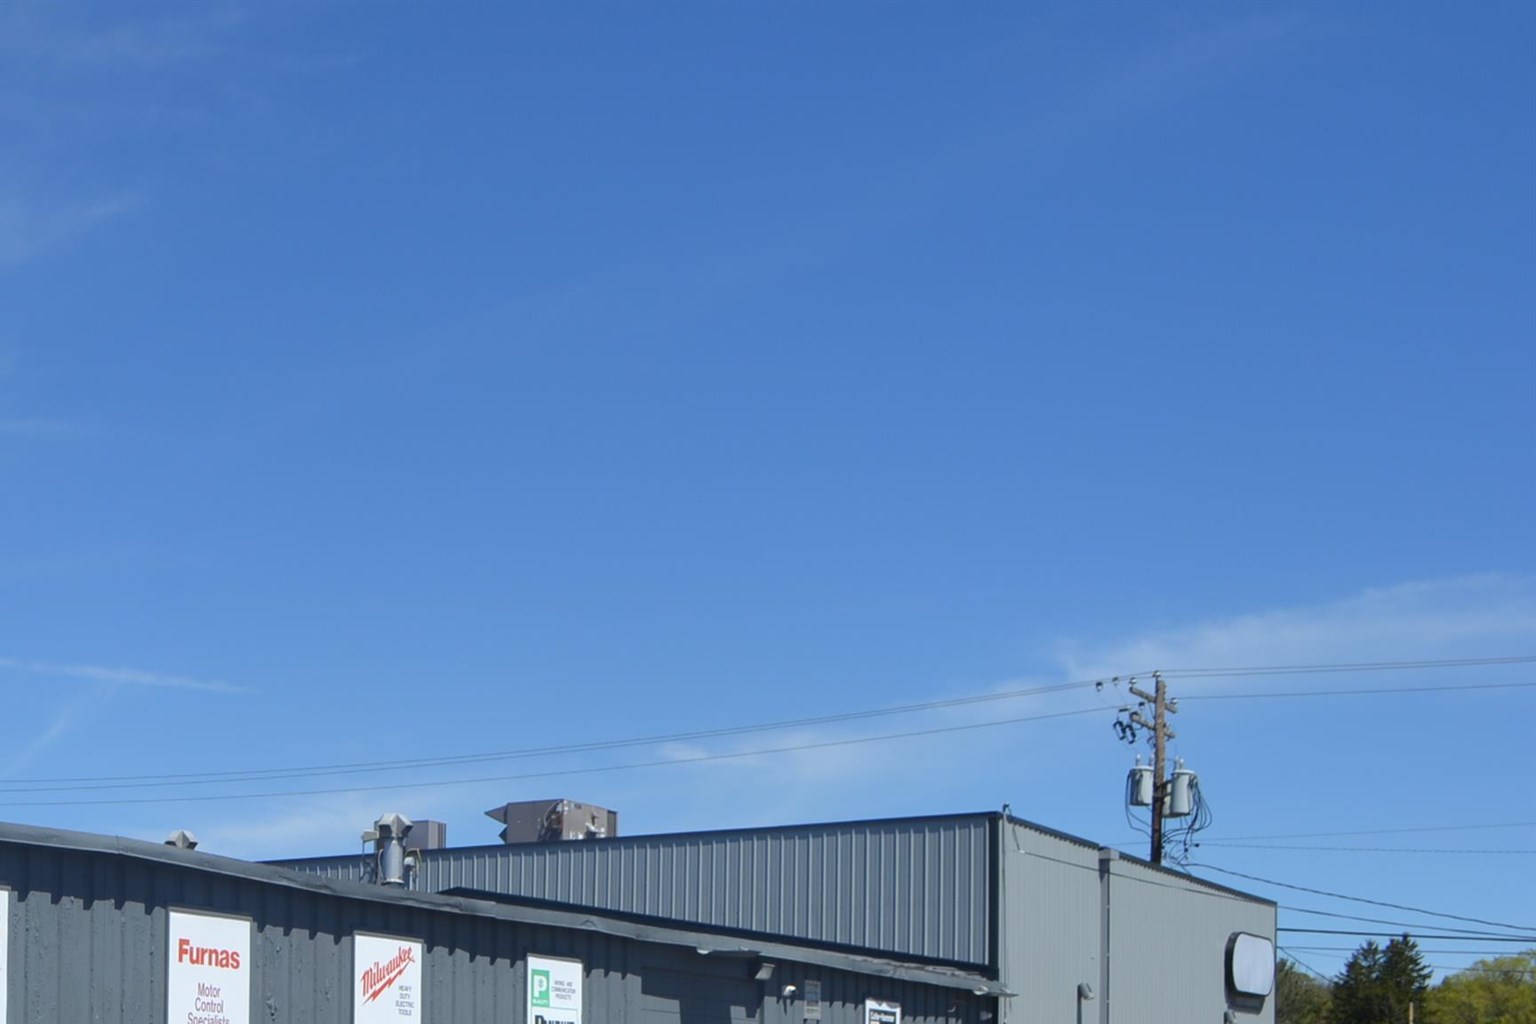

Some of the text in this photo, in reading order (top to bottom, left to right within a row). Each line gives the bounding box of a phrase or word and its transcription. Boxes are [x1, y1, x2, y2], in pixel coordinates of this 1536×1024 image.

[178, 938, 240, 969] Furnas
[360, 946, 413, 997] Milwaukee
[198, 982, 221, 998] Motor
[195, 997, 223, 1013] Control
